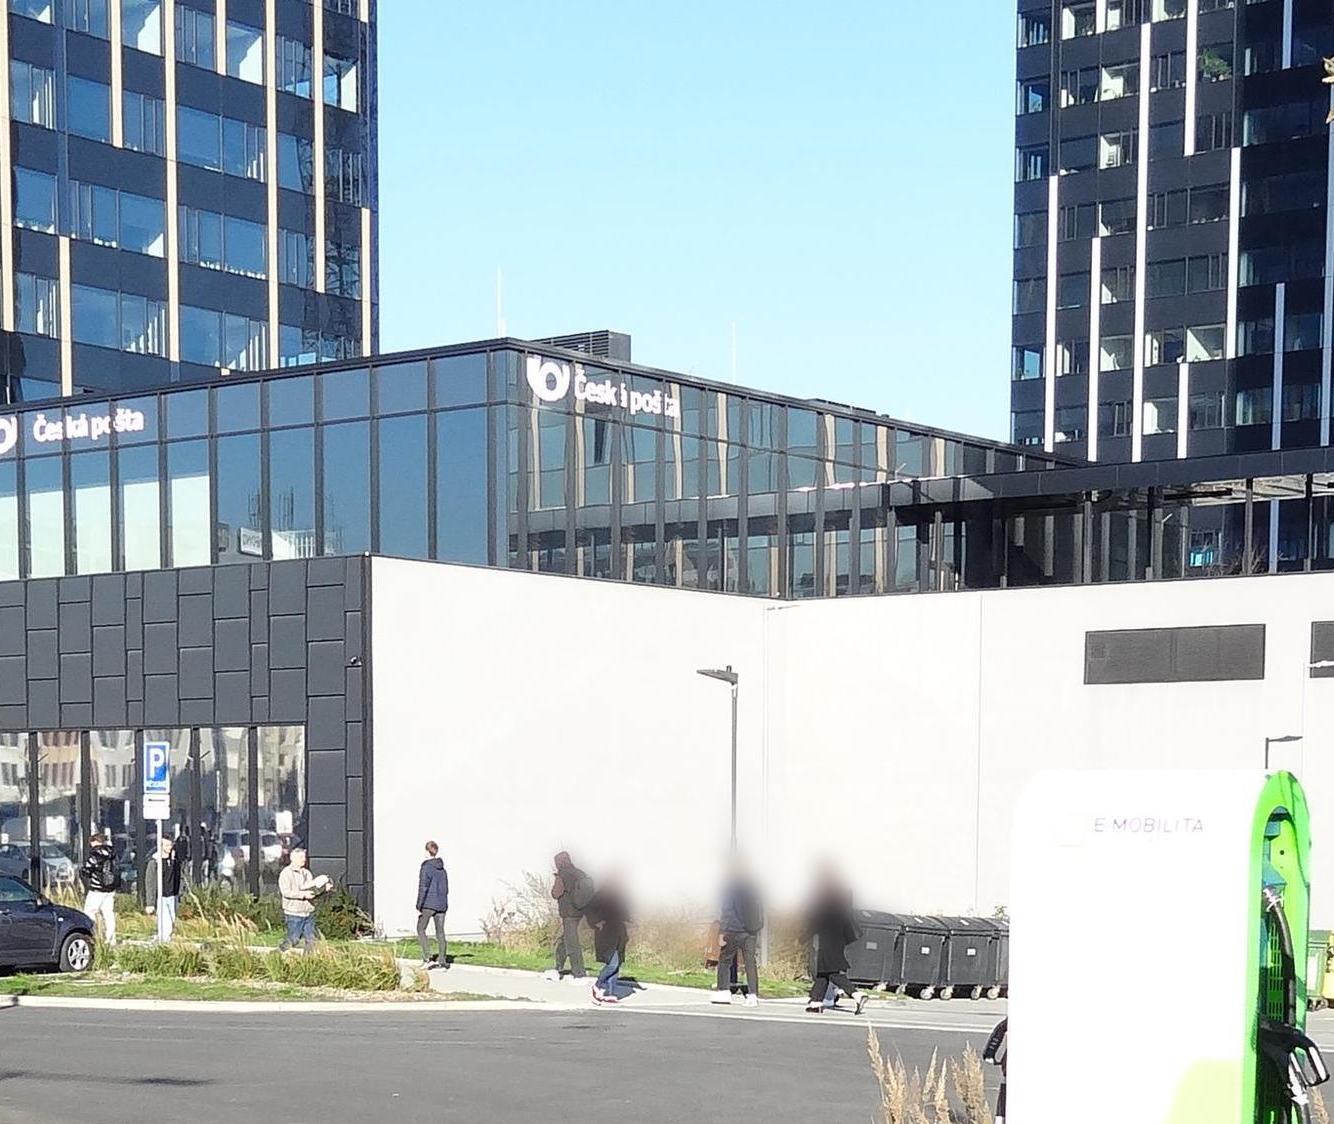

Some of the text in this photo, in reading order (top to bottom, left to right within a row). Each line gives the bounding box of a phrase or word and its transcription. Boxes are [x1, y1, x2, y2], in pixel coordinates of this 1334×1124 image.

[575, 369, 680, 418] Česká pošta
[33, 408, 144, 442] Česká pošta
[150, 748, 165, 779] P
